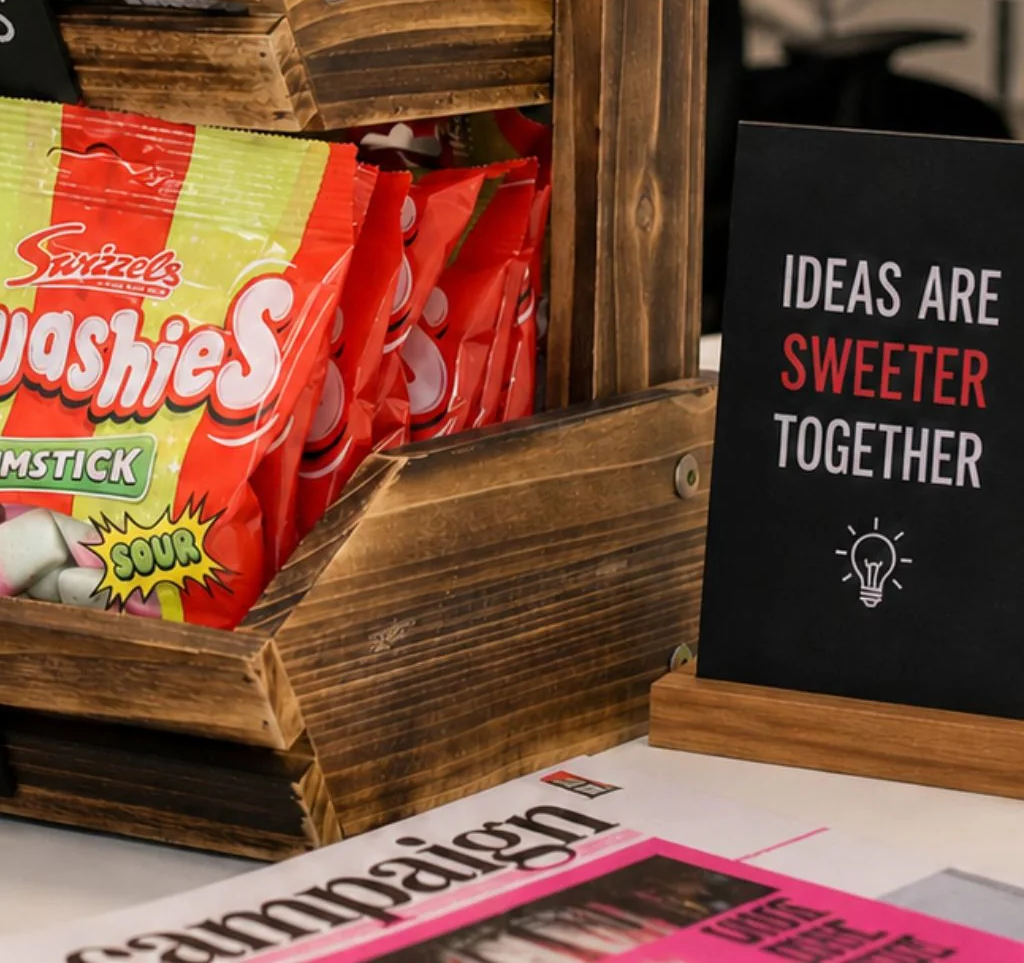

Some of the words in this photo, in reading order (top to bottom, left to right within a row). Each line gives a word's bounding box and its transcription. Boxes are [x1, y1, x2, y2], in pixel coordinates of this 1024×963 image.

[4, 222, 183, 288] Swizzels
[782, 253, 902, 319] IDEAS
[918, 264, 1002, 327] ARE
[780, 332, 989, 409] SWEETER
[774, 412, 984, 489] TOGETHER
[110, 526, 204, 581] SOUR
